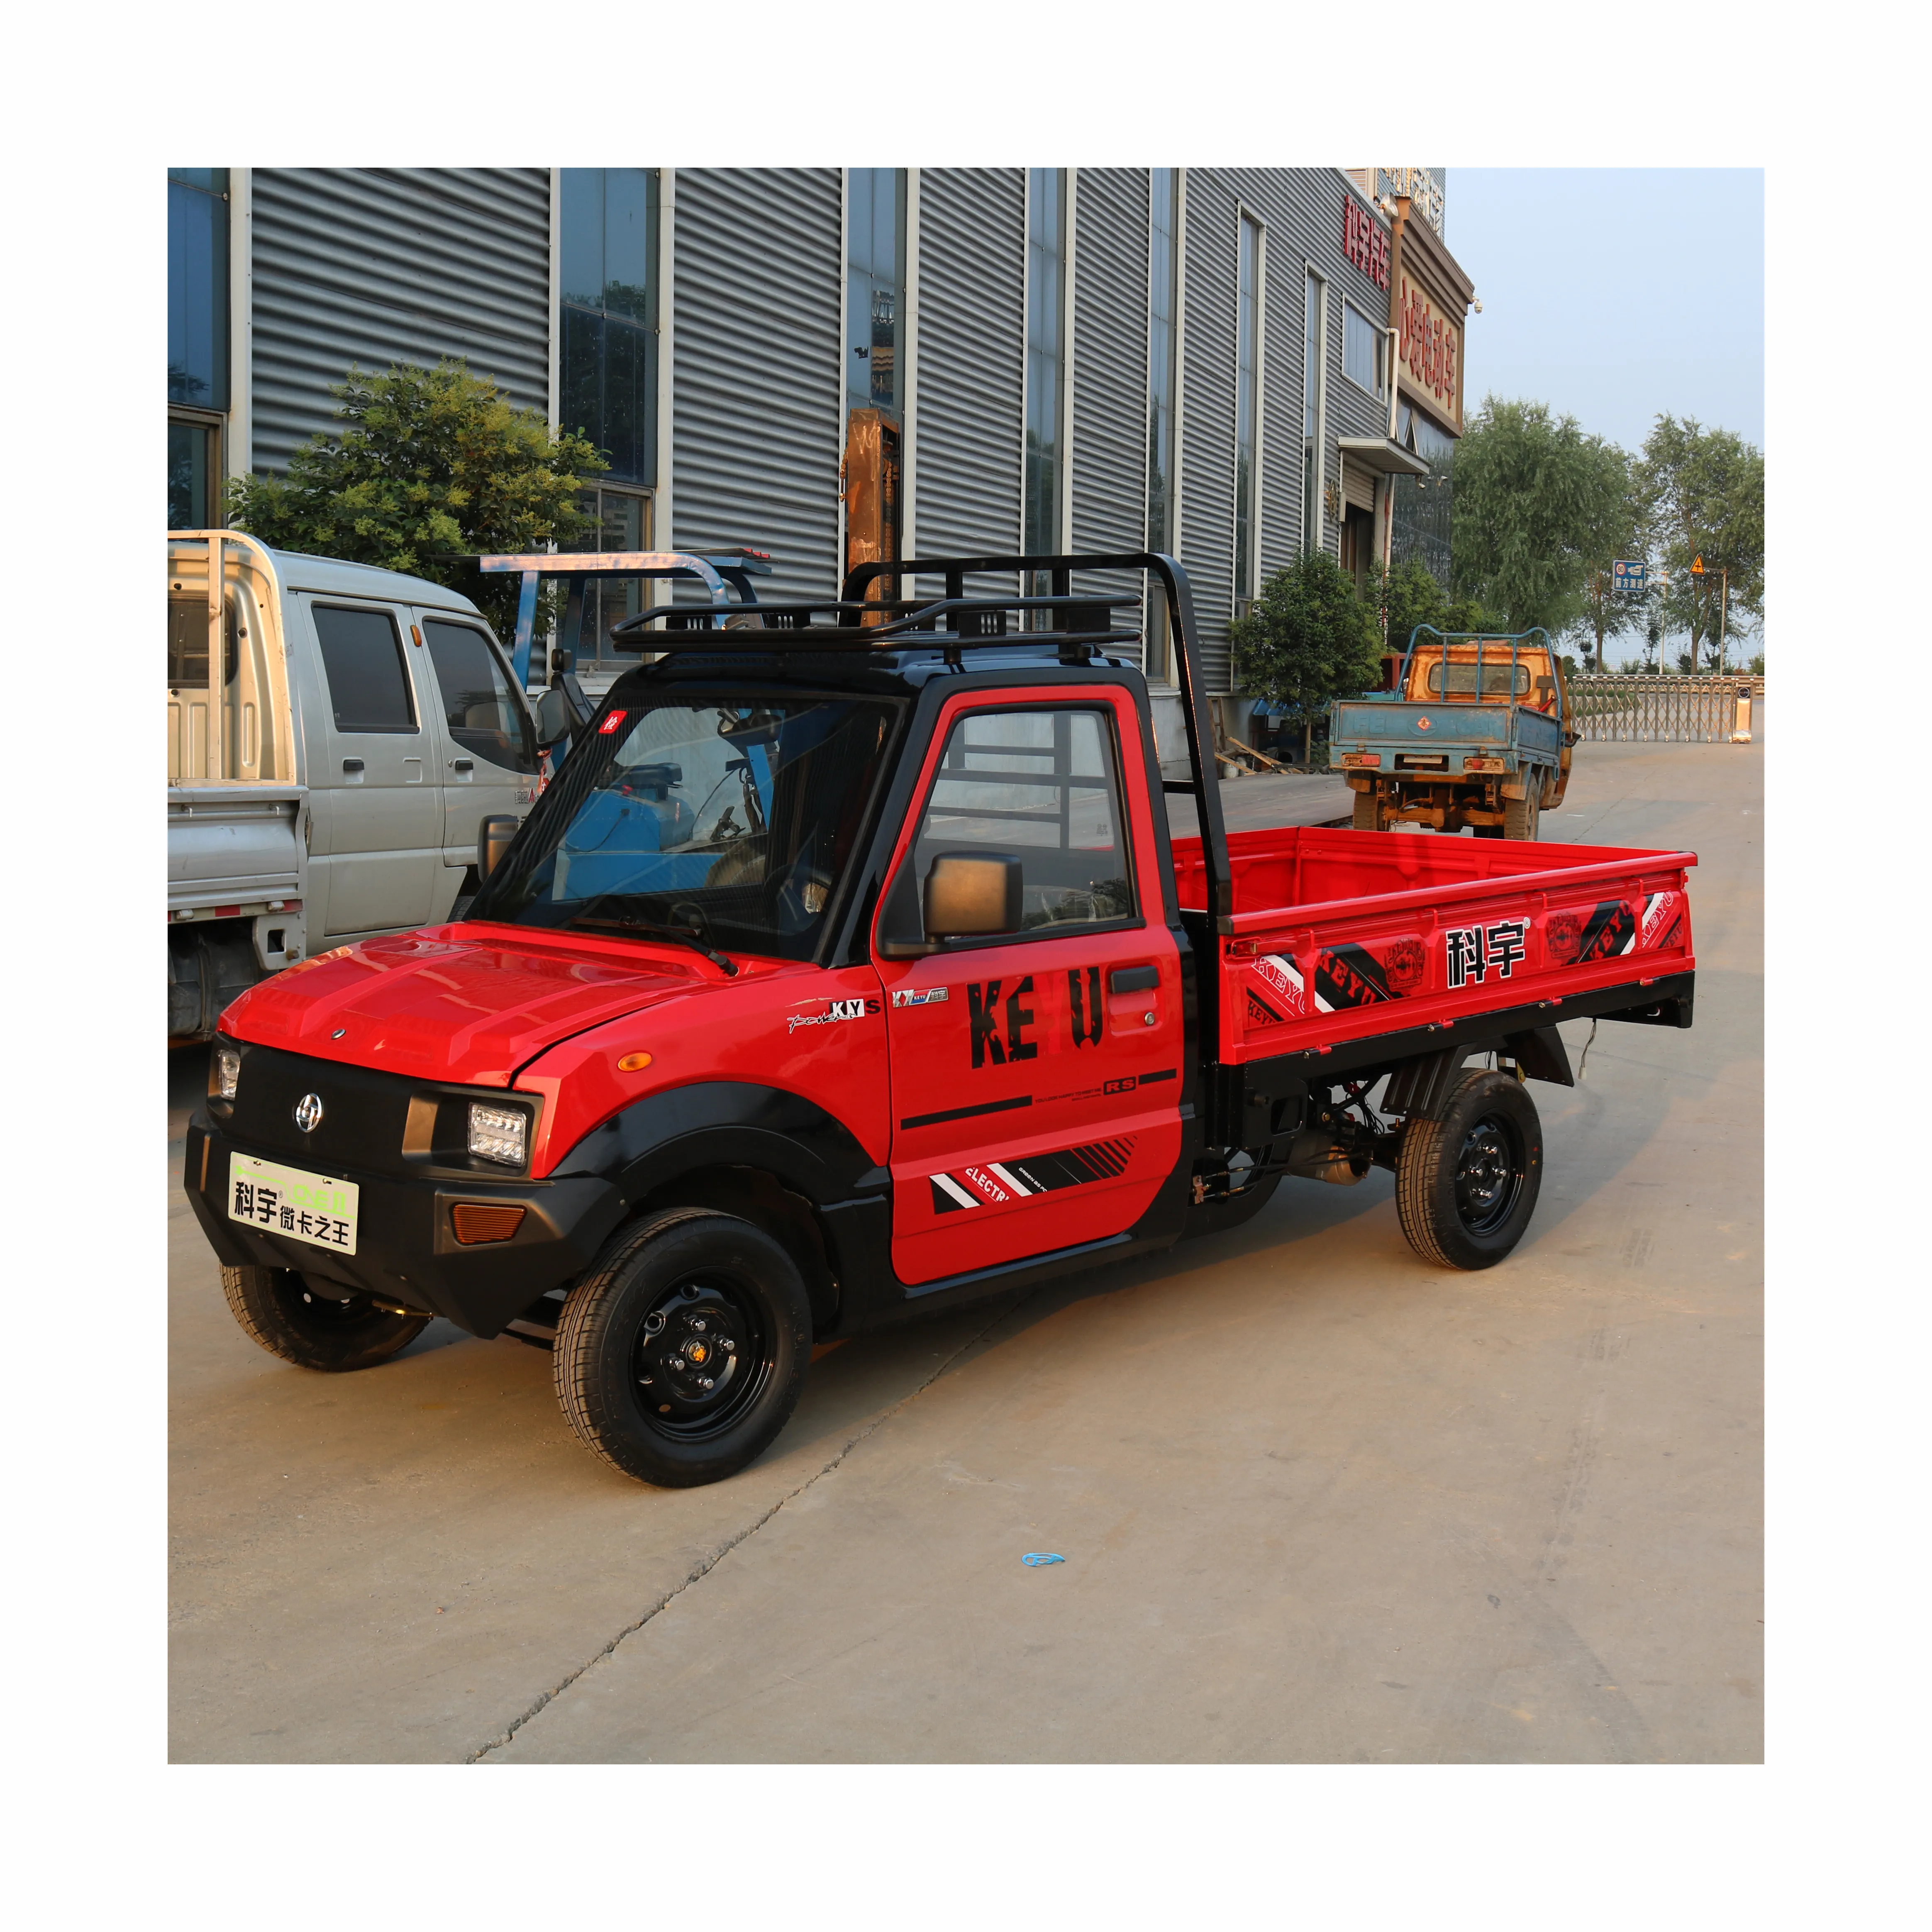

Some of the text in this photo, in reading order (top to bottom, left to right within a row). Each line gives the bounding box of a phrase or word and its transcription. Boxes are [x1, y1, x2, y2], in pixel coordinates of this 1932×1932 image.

[1615, 577, 1643, 589] 前方测速
[1106, 1078, 1135, 1093] RS
